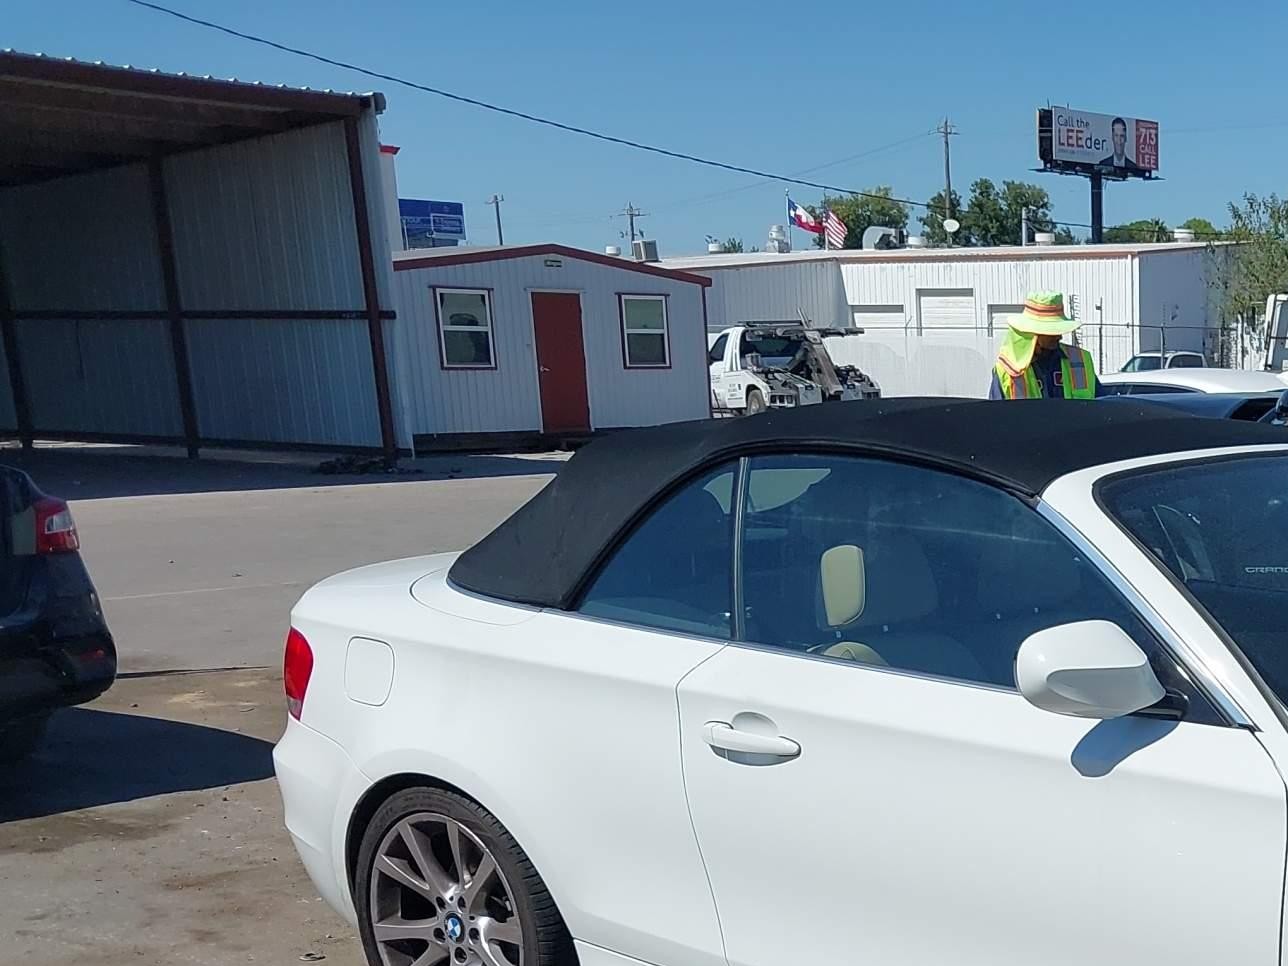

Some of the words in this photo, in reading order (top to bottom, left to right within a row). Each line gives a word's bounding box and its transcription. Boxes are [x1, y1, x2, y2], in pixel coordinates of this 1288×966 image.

[1057, 114, 1074, 127] Call
[1076, 117, 1090, 128] the
[1139, 127, 1157, 145] 713
[1139, 144, 1157, 155] CALL
[1139, 154, 1157, 169] LEE
